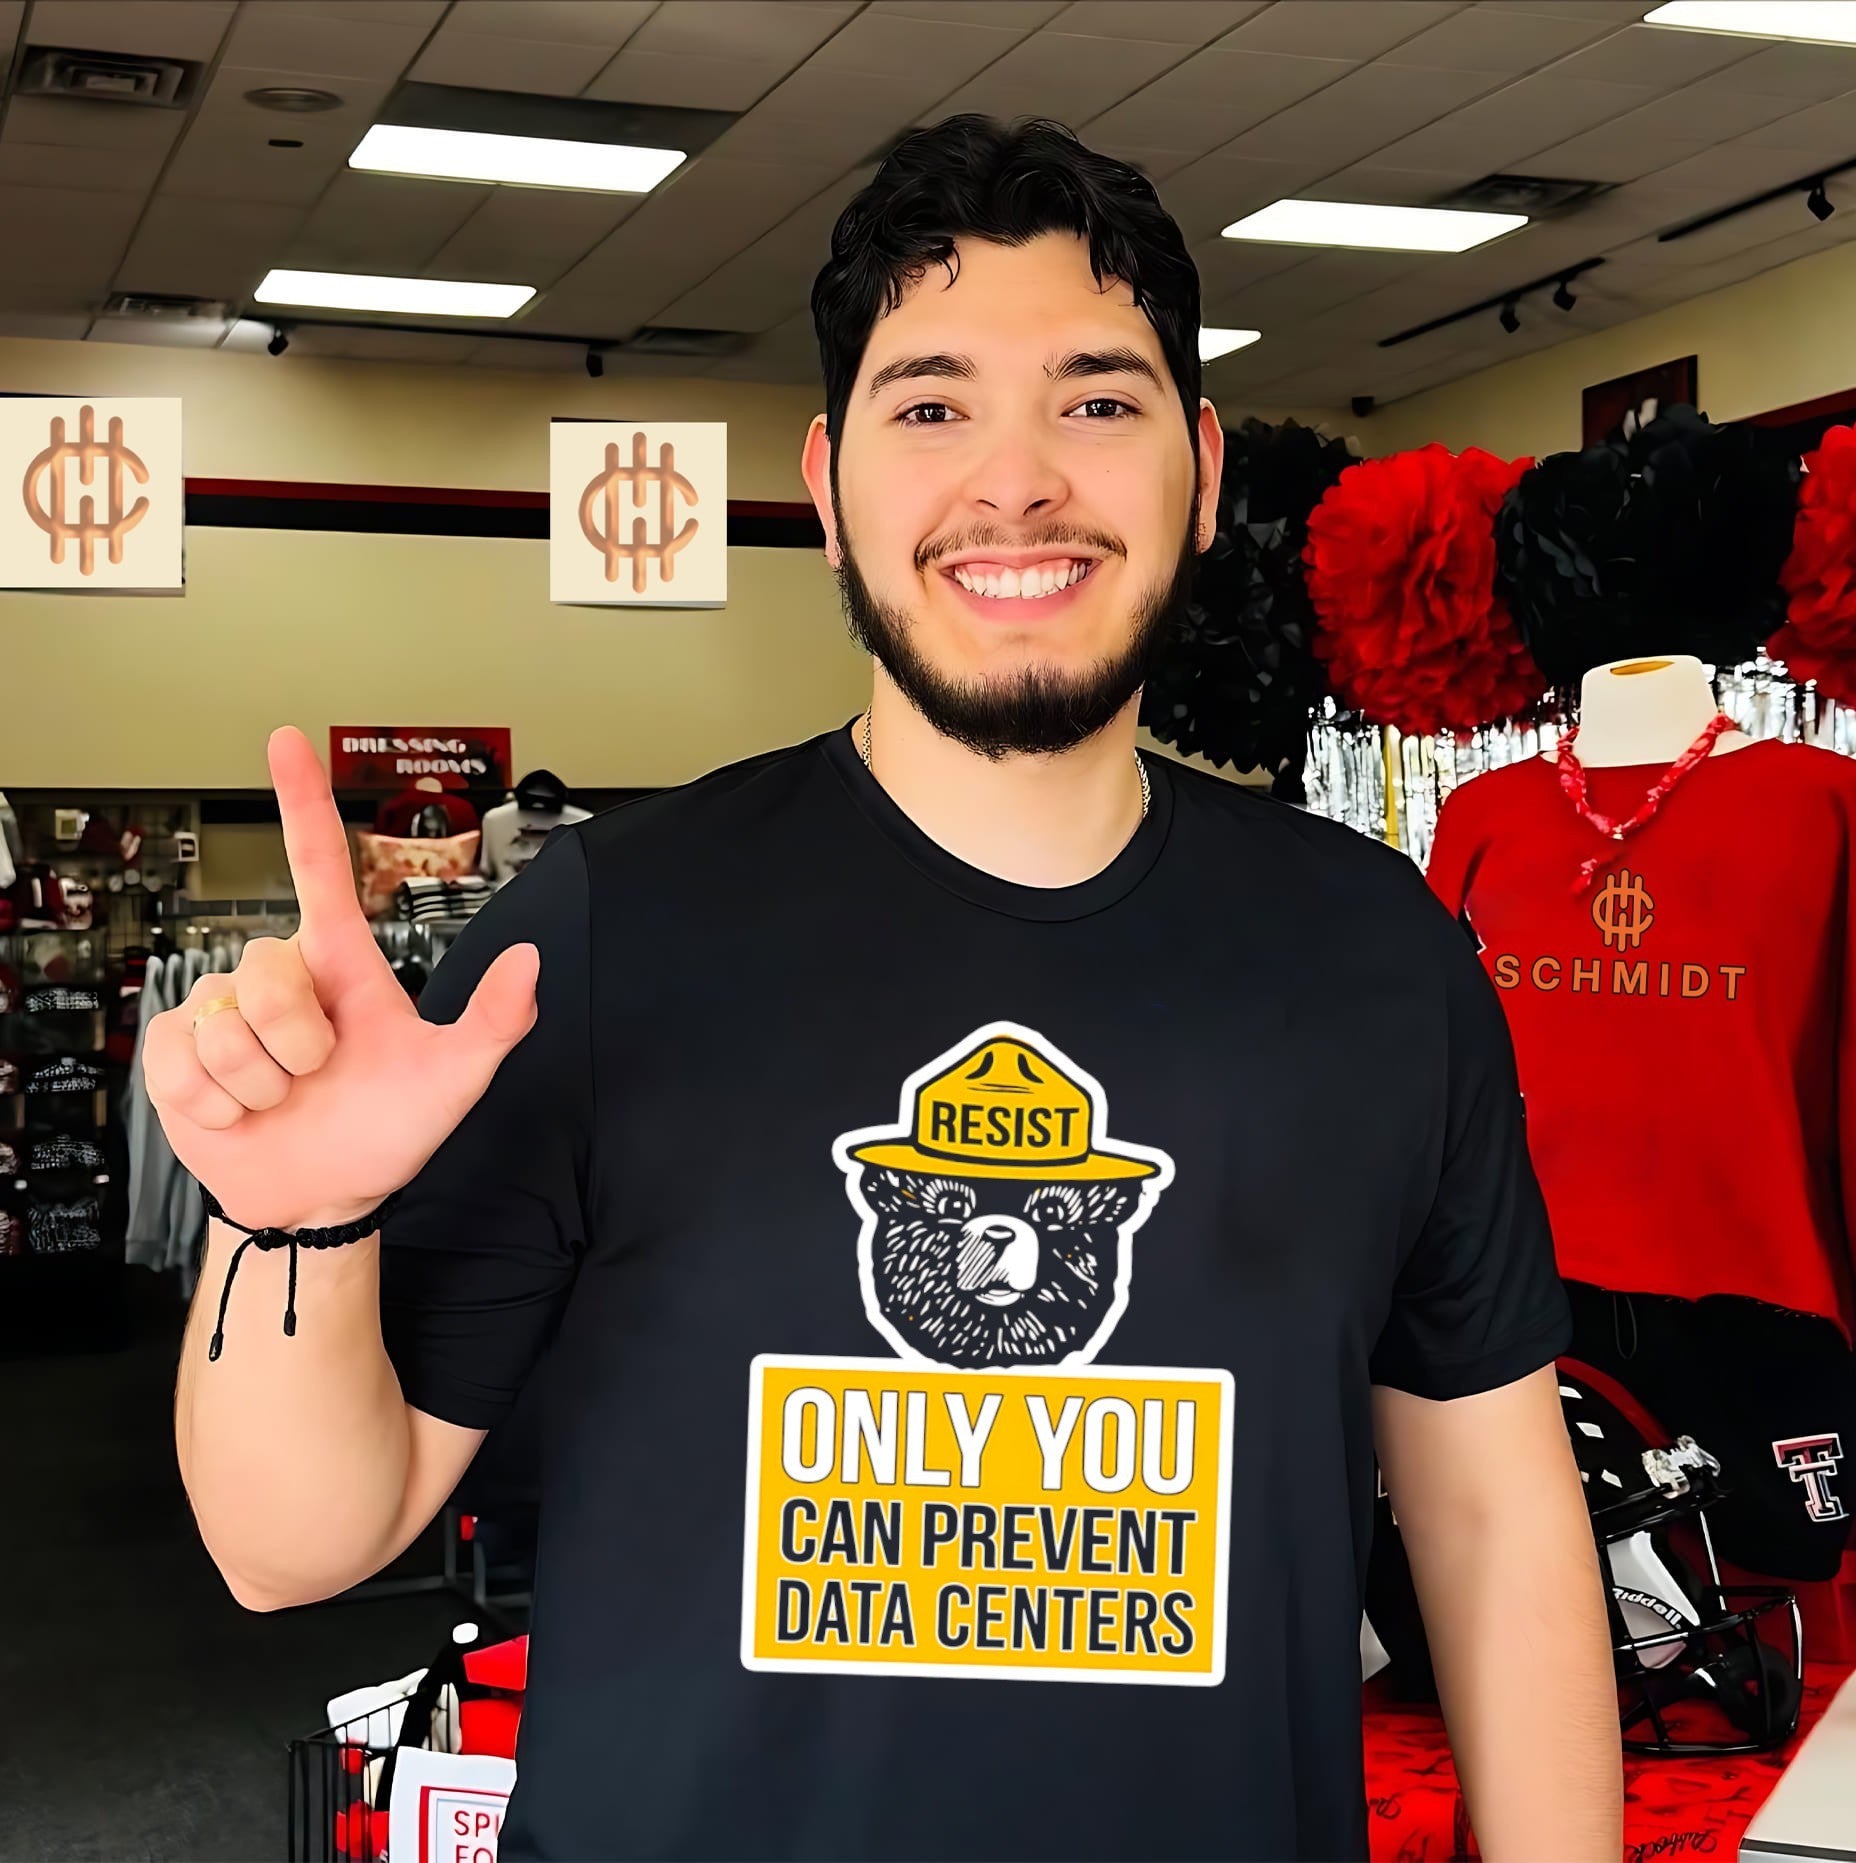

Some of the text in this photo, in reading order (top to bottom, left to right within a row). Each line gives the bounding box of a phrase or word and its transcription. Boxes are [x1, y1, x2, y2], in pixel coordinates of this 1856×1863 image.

[396, 758, 487, 775] ROOMS
[1494, 953, 1747, 1000] SCHMIDT
[930, 1101, 1080, 1148] RESIST
[782, 1386, 1197, 1496] ONLY YOU
[780, 1498, 1198, 1576] CAN PREVENT
[774, 1578, 1195, 1657] DATA CENTERS
